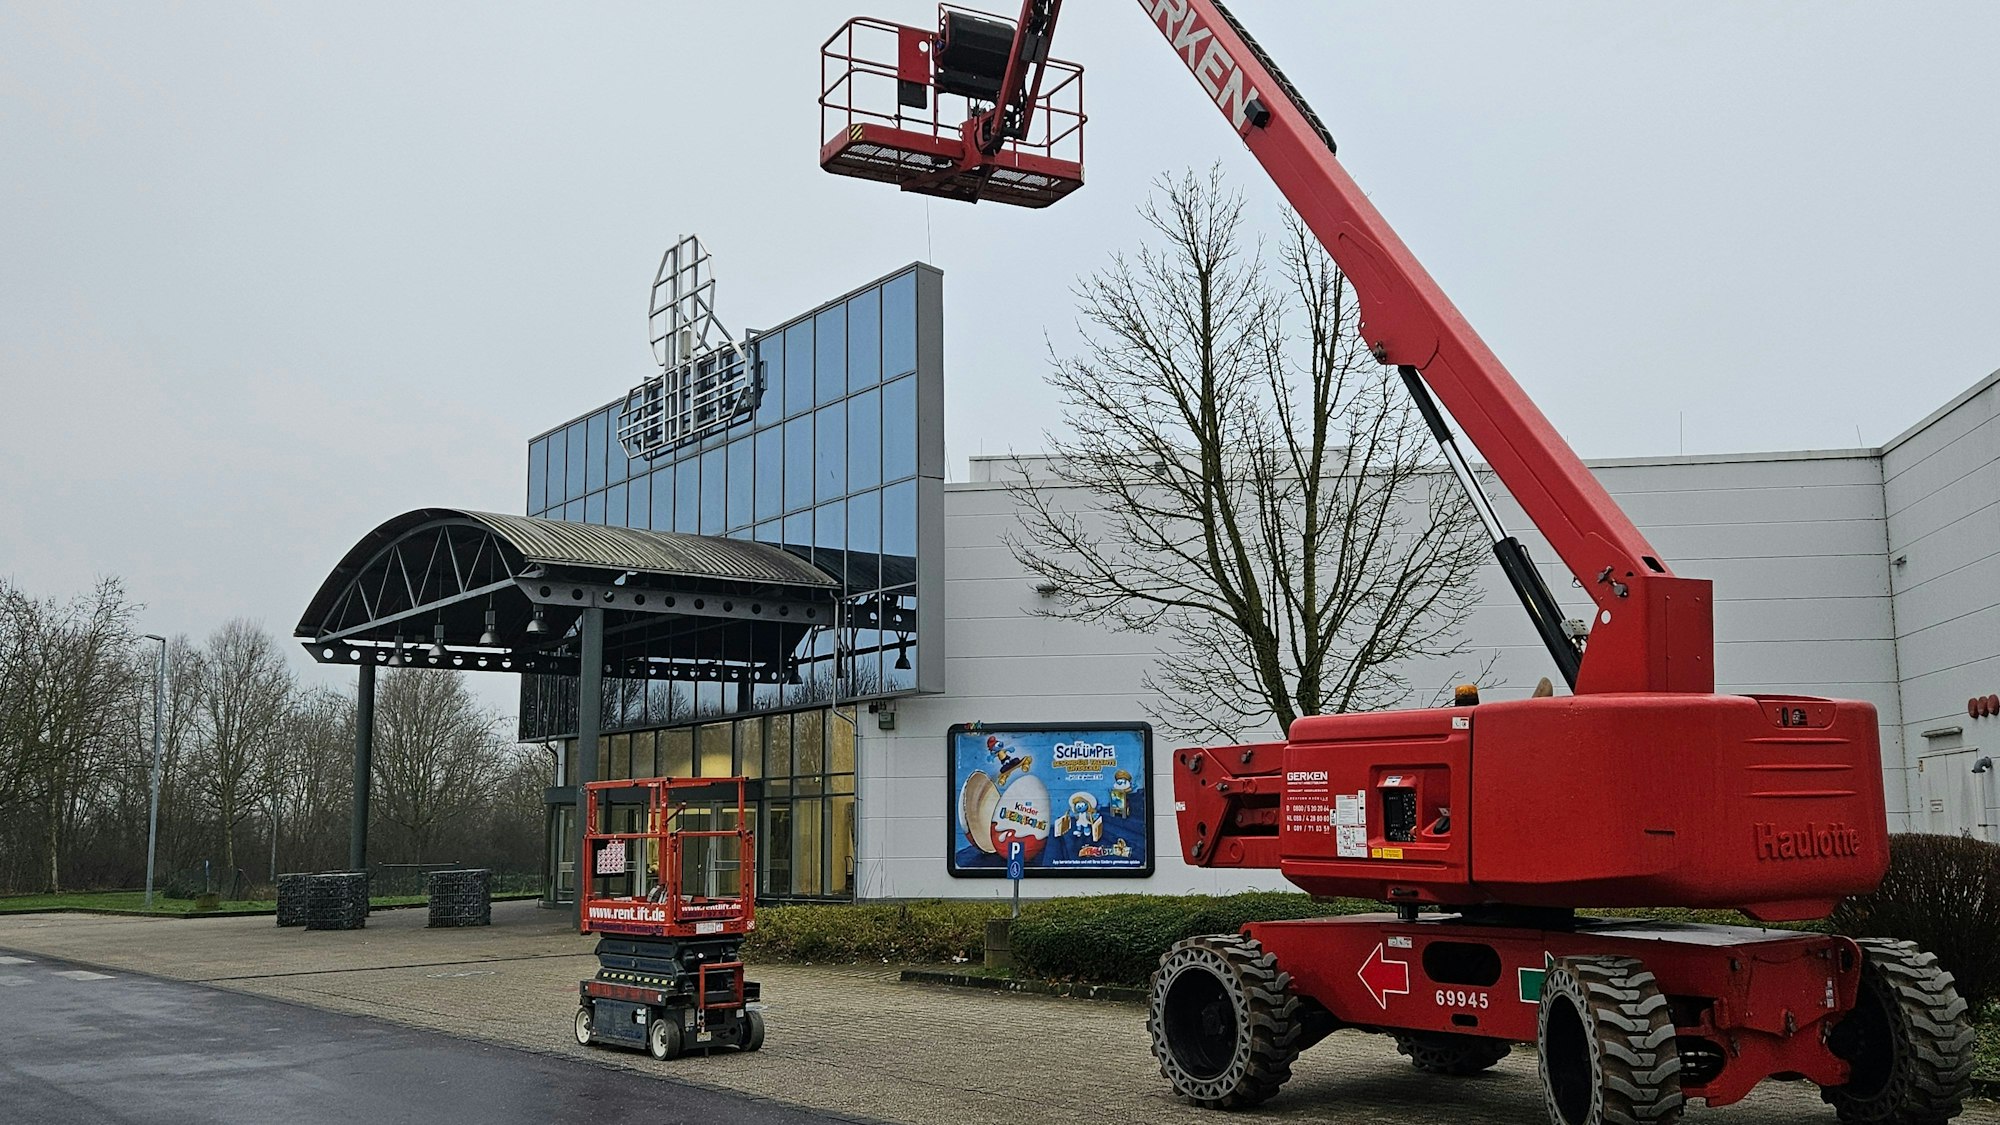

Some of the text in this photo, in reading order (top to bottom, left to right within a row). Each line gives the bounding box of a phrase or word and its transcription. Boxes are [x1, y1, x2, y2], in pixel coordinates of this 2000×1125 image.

[1056, 745, 1113, 758] SCHLÜMPFE
[1287, 771, 1328, 781] GERKEN
[1753, 822, 1860, 859] Haulotte
[1011, 842, 1020, 860] P
[1436, 989, 1489, 1009] 69945
